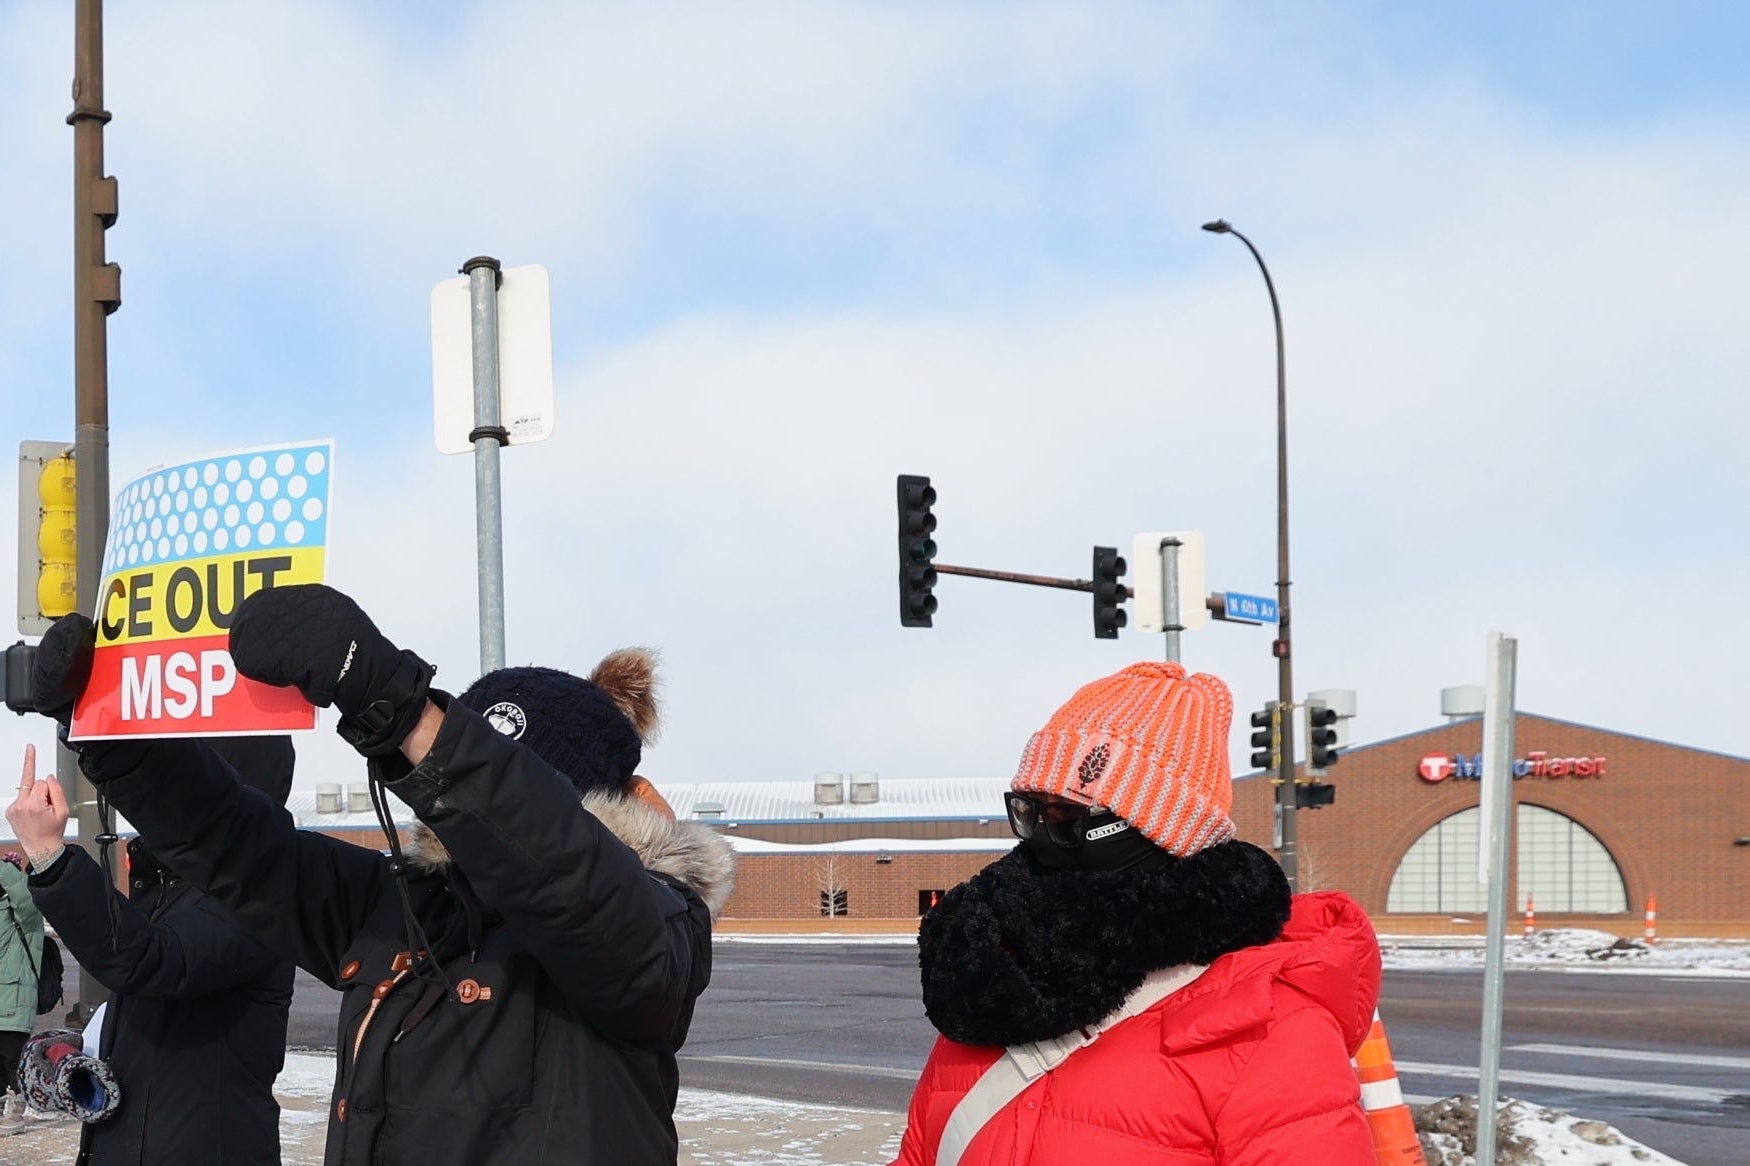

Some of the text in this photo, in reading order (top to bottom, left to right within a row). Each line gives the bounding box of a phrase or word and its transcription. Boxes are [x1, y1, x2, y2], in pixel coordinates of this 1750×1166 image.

[95, 572, 154, 642] CE
[1230, 597, 1239, 612] N
[120, 649, 237, 721] MSP
[494, 702, 525, 727] OKOBOJI
[1089, 821, 1127, 838] BATTLE
